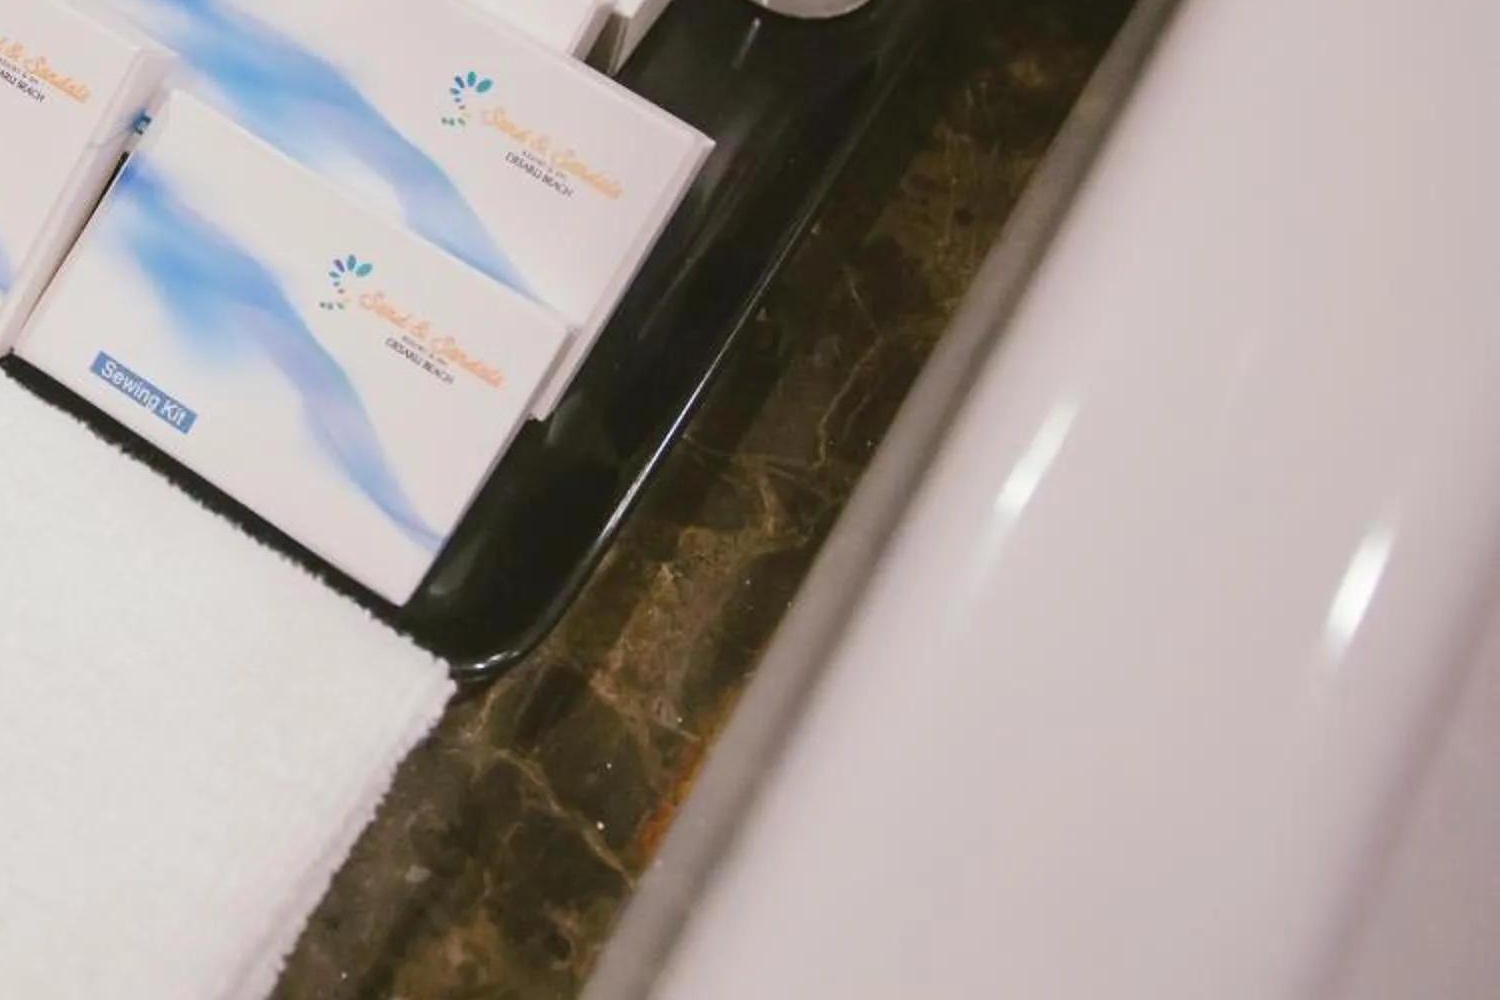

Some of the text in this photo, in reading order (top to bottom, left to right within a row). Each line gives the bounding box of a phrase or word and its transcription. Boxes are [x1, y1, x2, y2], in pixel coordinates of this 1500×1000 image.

[22, 56, 90, 104] Sandals
[101, 360, 187, 426] Sewing Kit
